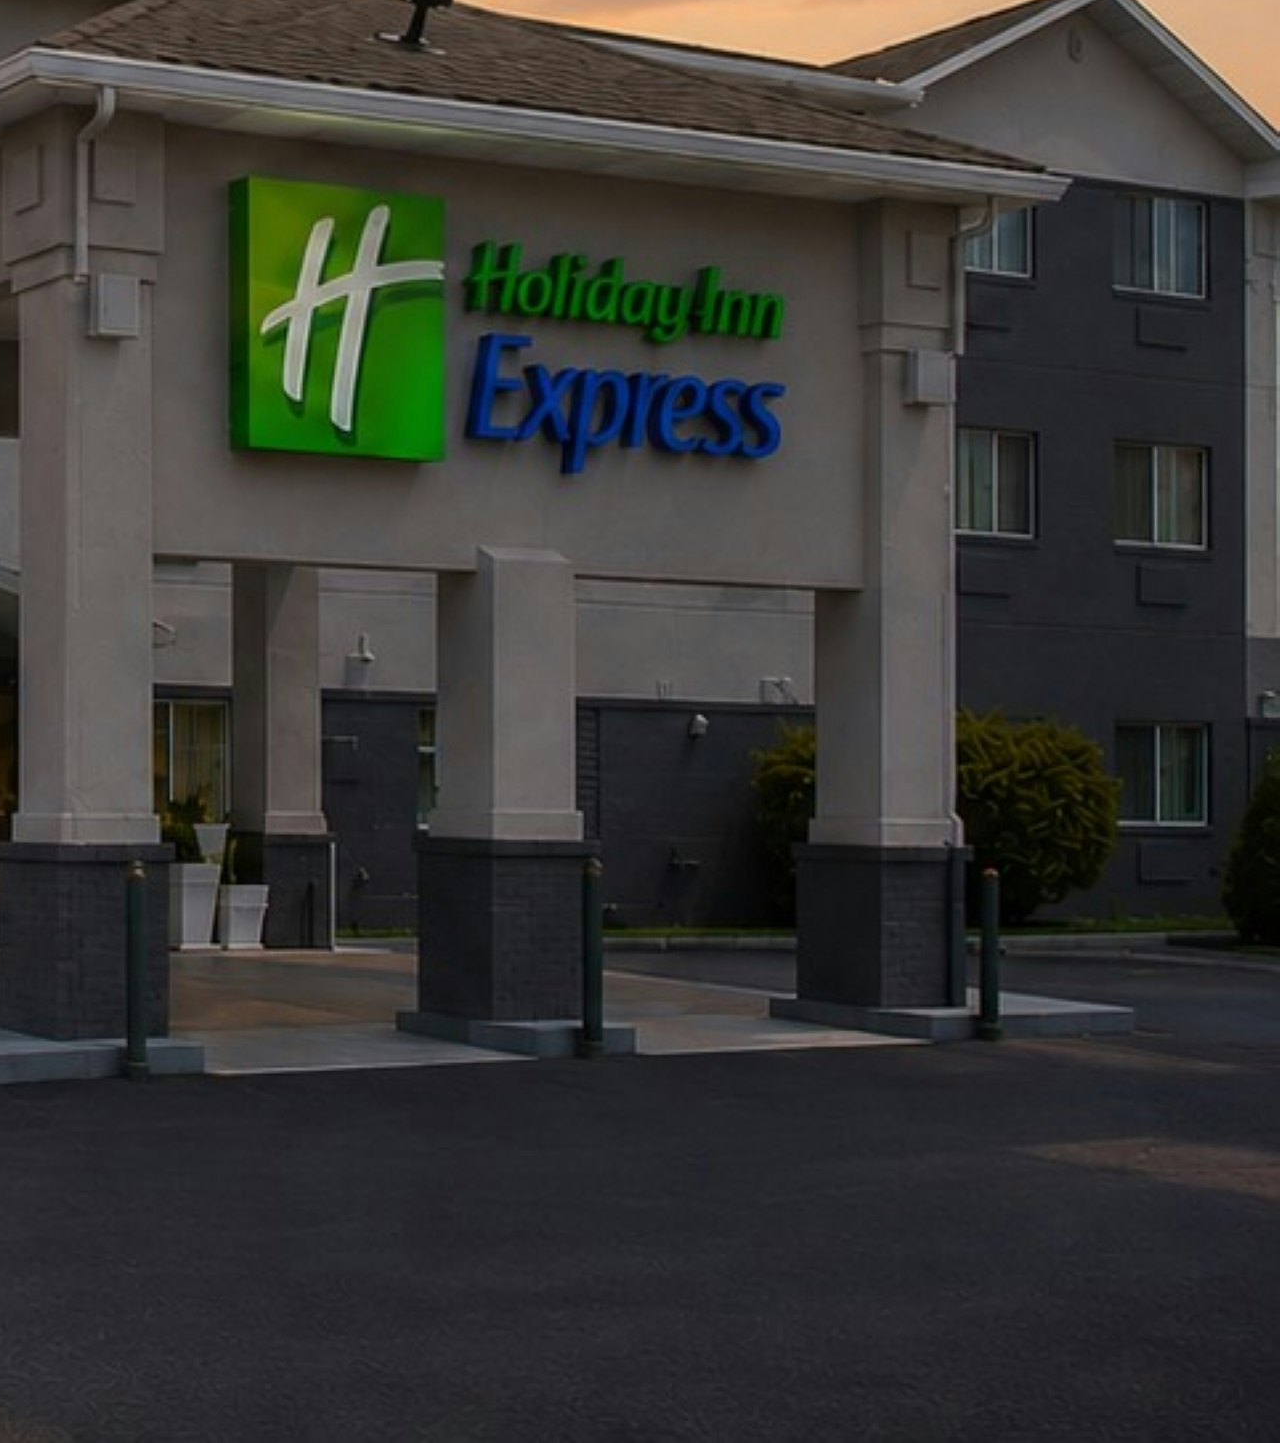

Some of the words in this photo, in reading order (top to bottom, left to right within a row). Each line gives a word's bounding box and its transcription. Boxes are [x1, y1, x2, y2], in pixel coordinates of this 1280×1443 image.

[463, 241, 688, 343] Holiday
[695, 266, 784, 340] Inn
[465, 332, 786, 474] Express
